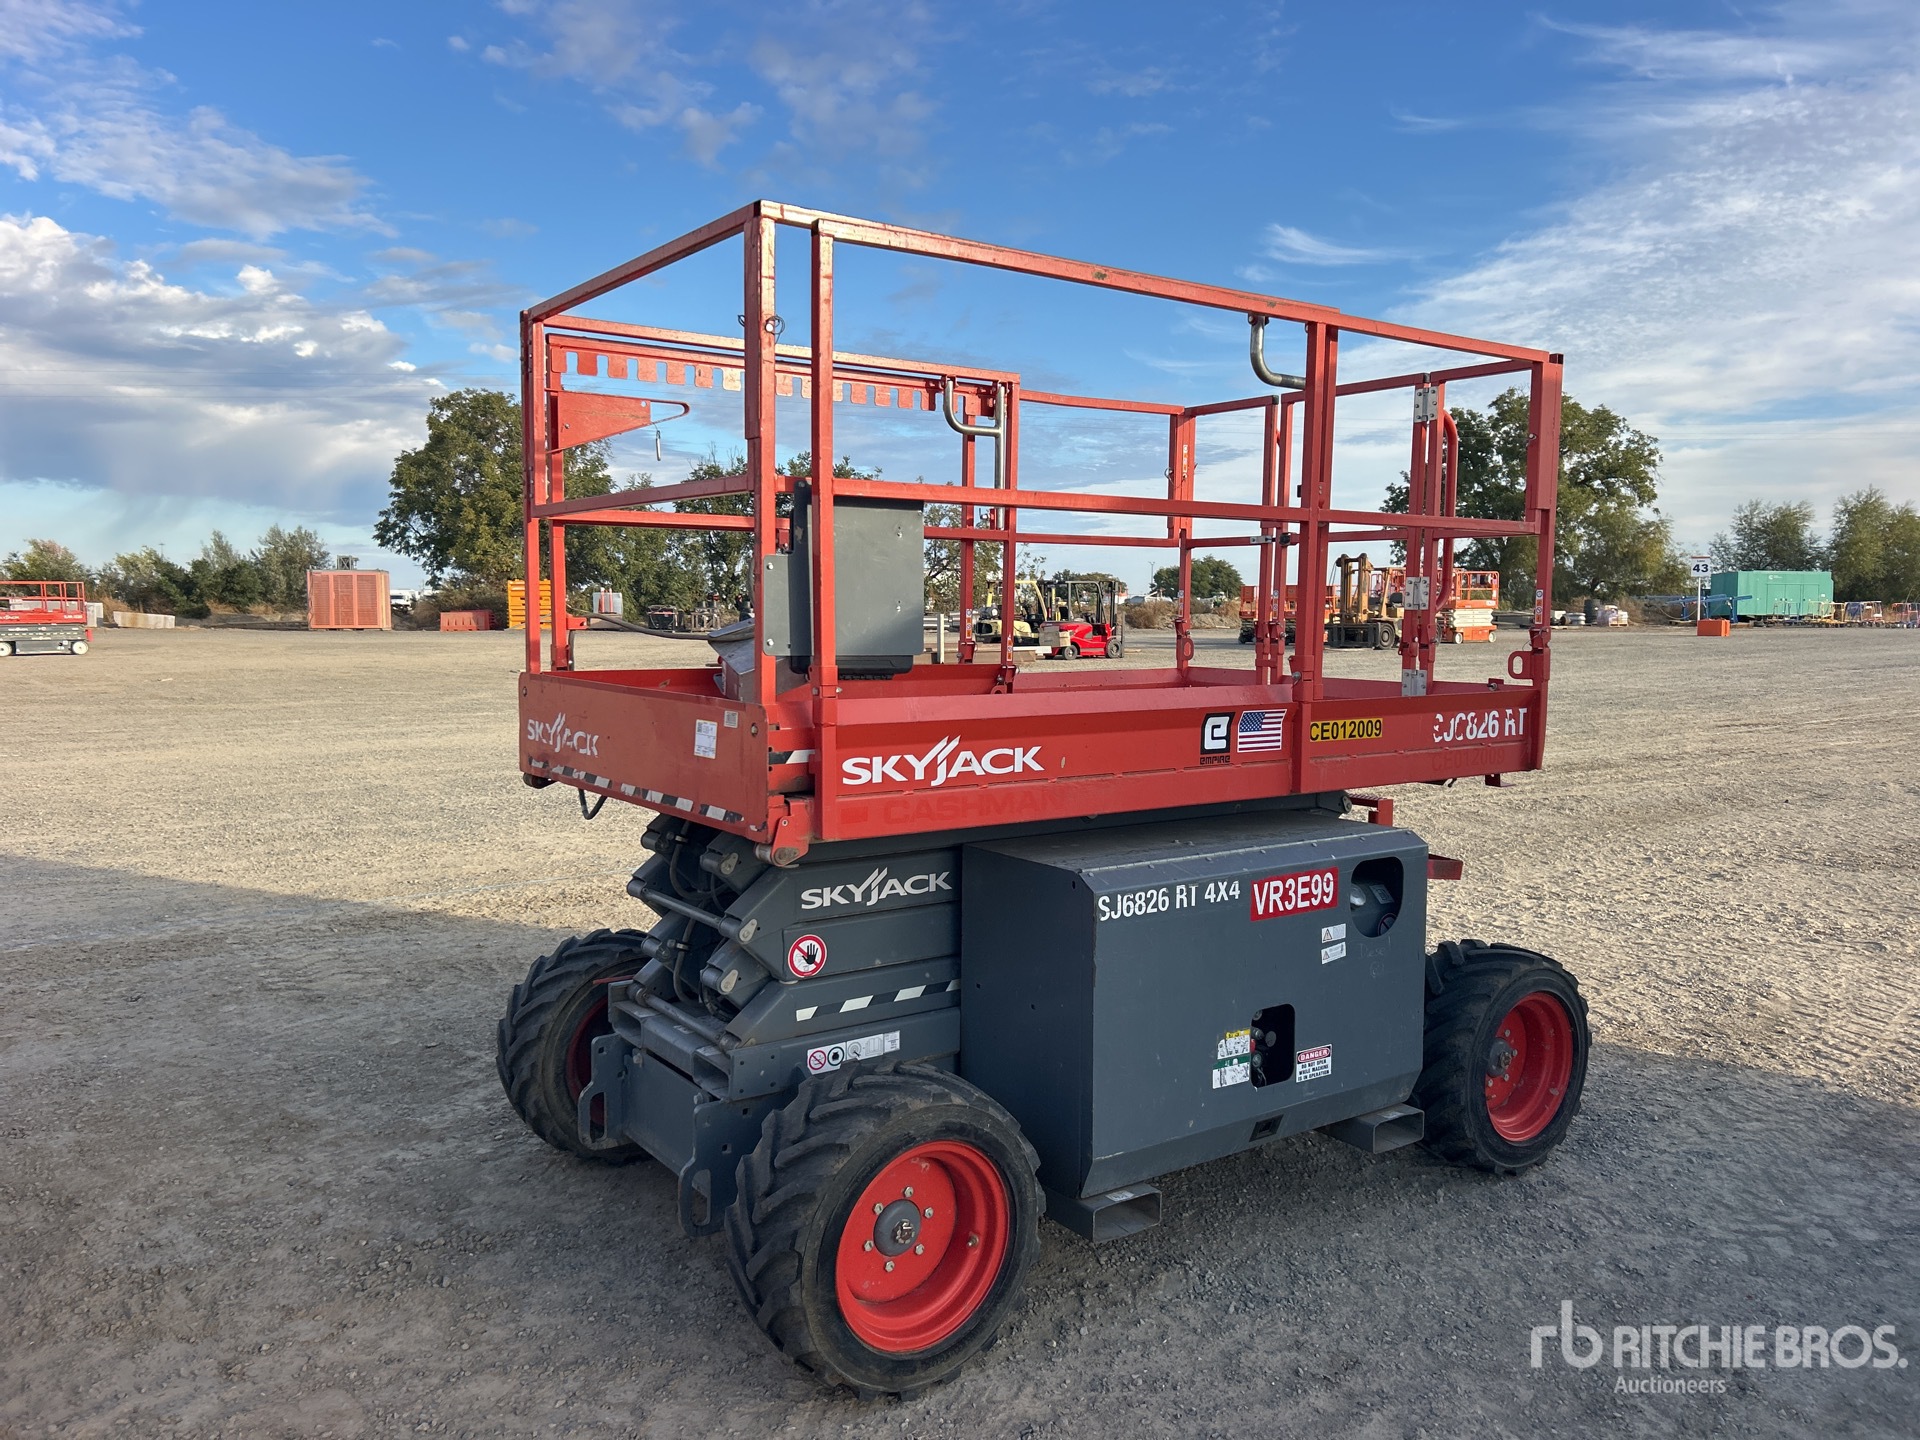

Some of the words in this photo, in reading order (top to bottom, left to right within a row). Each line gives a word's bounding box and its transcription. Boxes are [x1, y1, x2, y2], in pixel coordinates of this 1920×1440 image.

[1692, 564, 1709, 573] 43
[527, 712, 599, 757] SKYJACK
[1310, 719, 1382, 741] CE012009
[841, 735, 1045, 787] SKYJACK
[801, 867, 953, 910] SKYJACK
[1098, 887, 1170, 922] SJ6826
[1175, 884, 1199, 909] RT
[1204, 880, 1241, 903] 4X4
[1253, 872, 1335, 915] VR3E99
[1299, 1067, 1311, 1075] WHILE
[1312, 1064, 1329, 1072] MACHINE
[1300, 1048, 1329, 1061] DANGER
[1309, 1069, 1330, 1079] OPERATION
